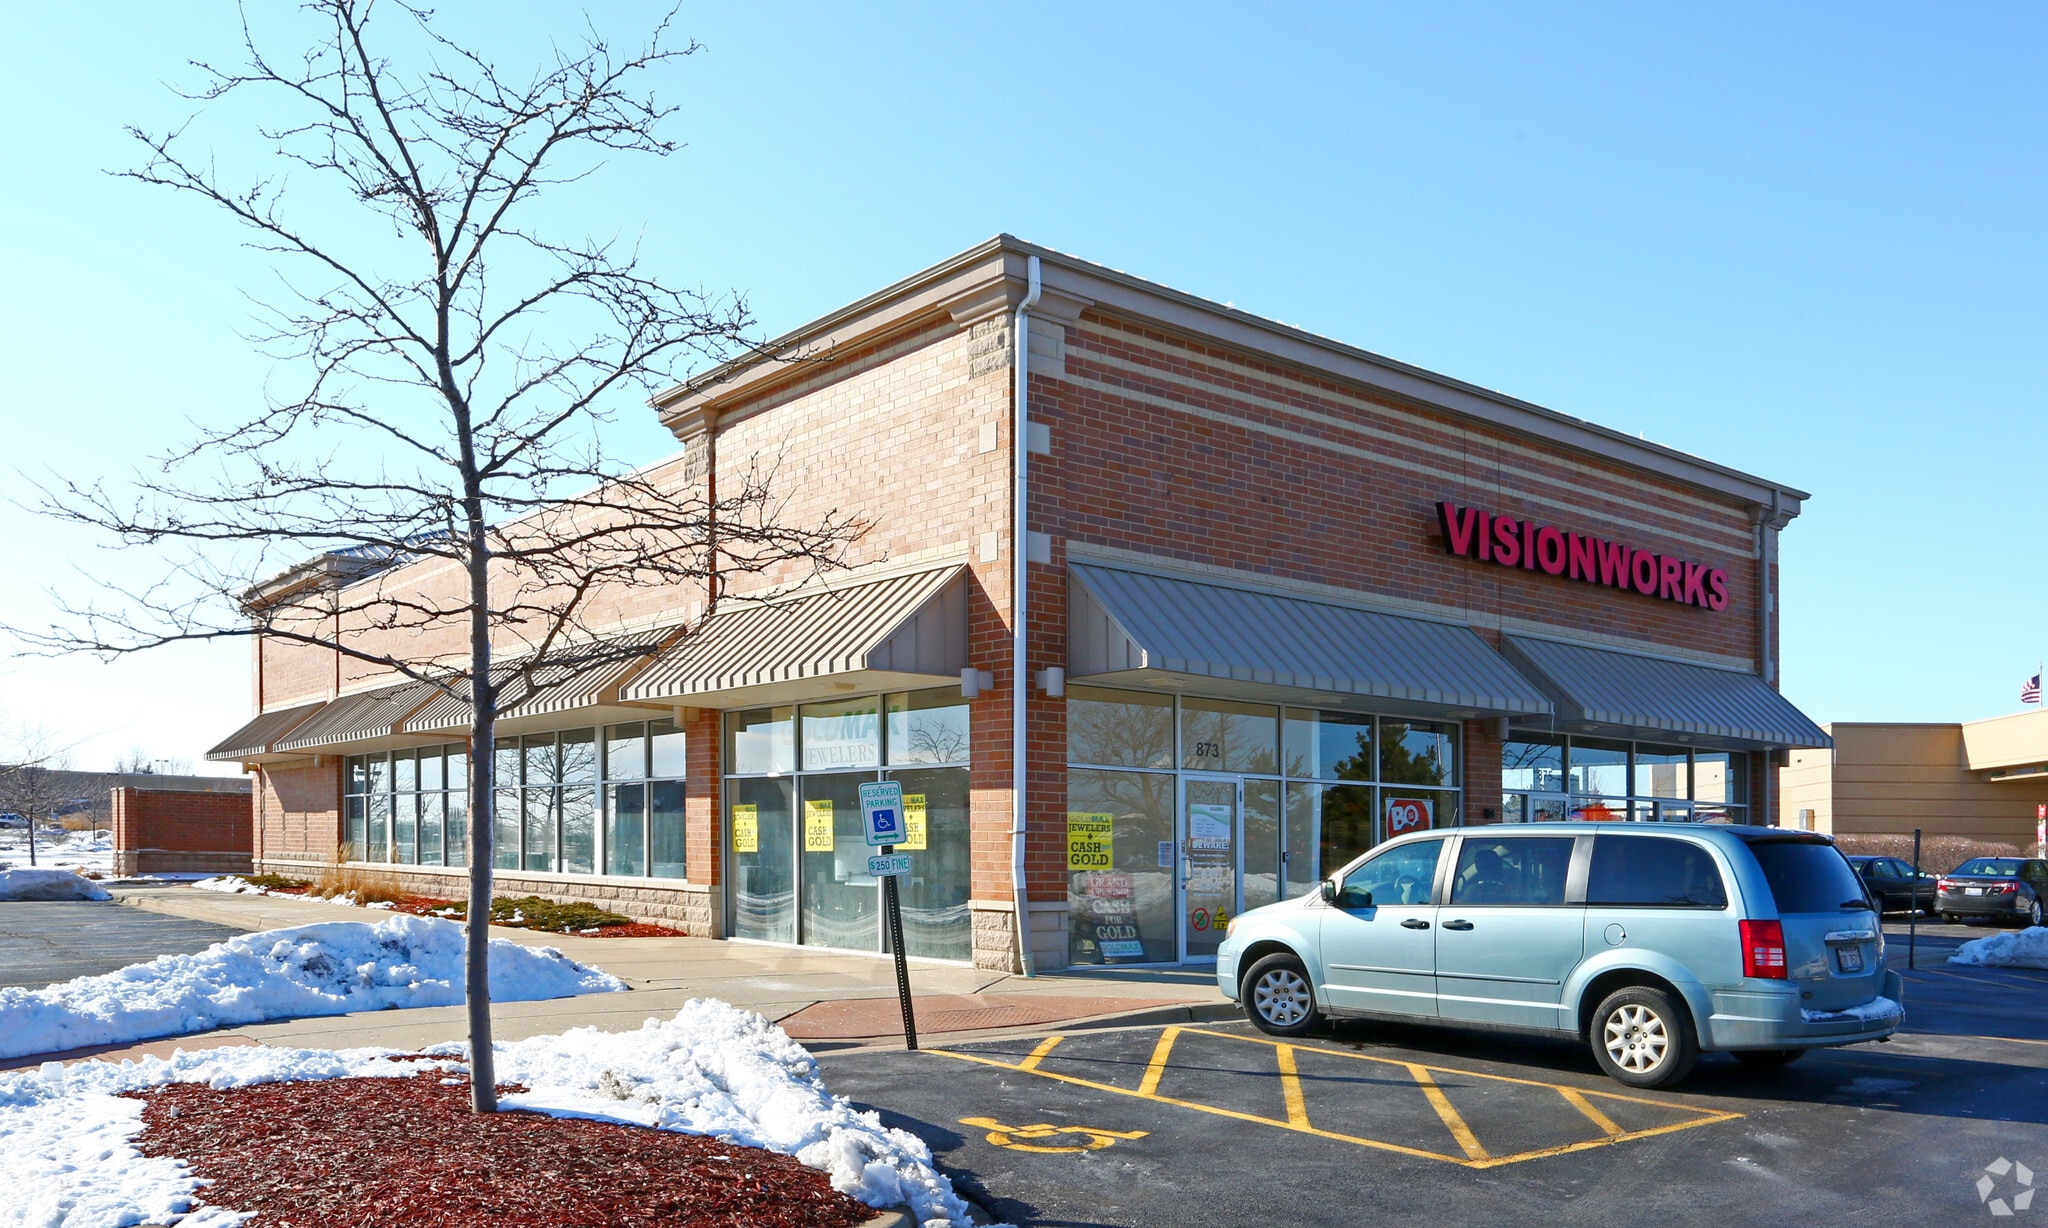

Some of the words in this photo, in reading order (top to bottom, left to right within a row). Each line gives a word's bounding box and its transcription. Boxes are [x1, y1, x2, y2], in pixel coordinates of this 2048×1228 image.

[1437, 502, 1729, 612] VISIONWORKS
[1196, 742, 1219, 757] 873
[863, 787, 899, 798] RESERVED
[866, 798, 898, 809] PARKING
[734, 828, 752, 837] CASH
[808, 826, 827, 836] CASH
[1068, 823, 1111, 833] JEWELERS
[735, 838, 756, 848] GOLD
[808, 836, 832, 847] GOLD
[906, 833, 924, 844] OLD
[1070, 841, 1101, 853] CASH
[891, 857, 908, 870] FINE
[1070, 854, 1109, 865] GOLD
[1090, 877, 1128, 887] GRAND
[1093, 899, 1131, 913] CASH
[1104, 915, 1123, 925] FOR
[1096, 925, 1136, 939] GOLD
